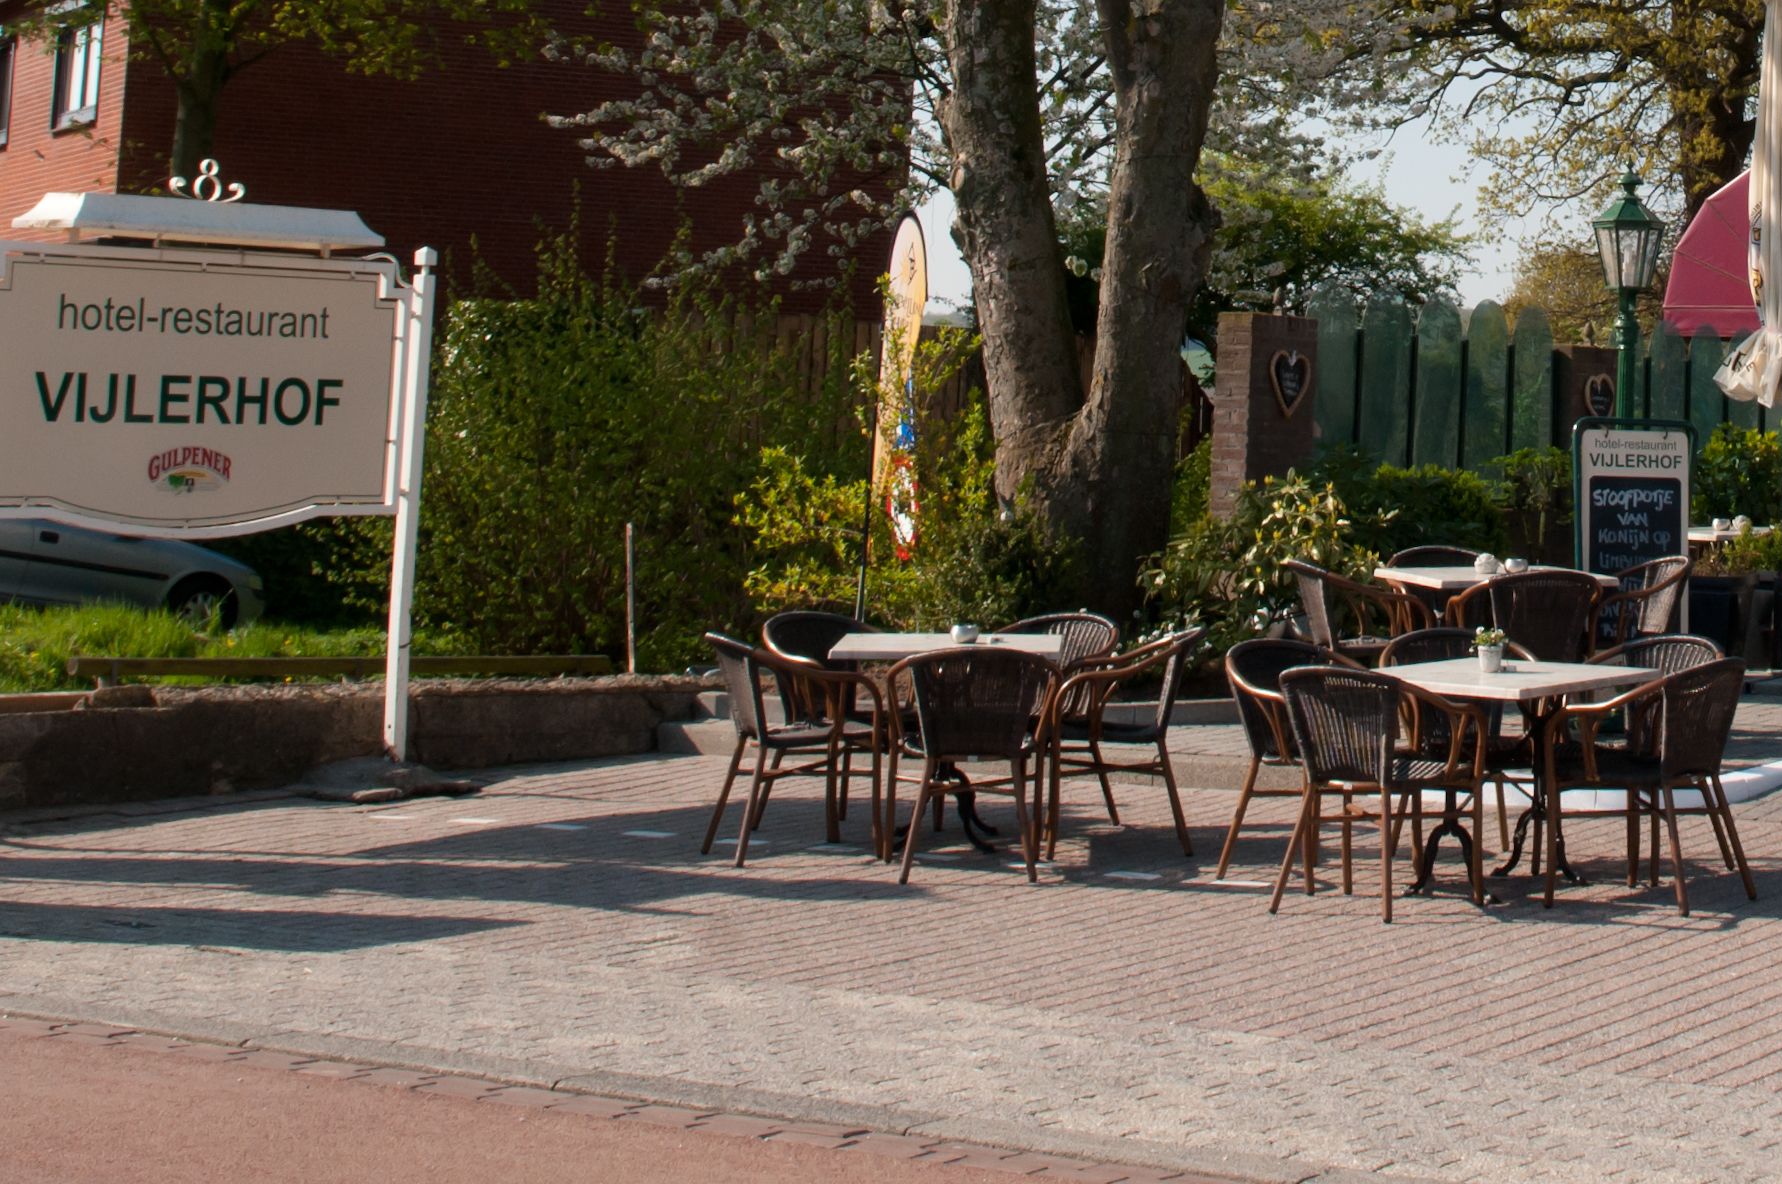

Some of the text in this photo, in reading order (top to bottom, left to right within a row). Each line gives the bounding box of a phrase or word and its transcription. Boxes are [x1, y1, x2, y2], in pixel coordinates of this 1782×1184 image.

[58, 293, 330, 339] hotel-restaurant
[35, 371, 344, 426] VIJLERHOF
[1595, 438, 1677, 451] hotel-restaurant
[148, 446, 232, 482] GULPENER
[1590, 453, 1682, 469] VIJLERHOF
[1617, 512, 1648, 527] VAN
